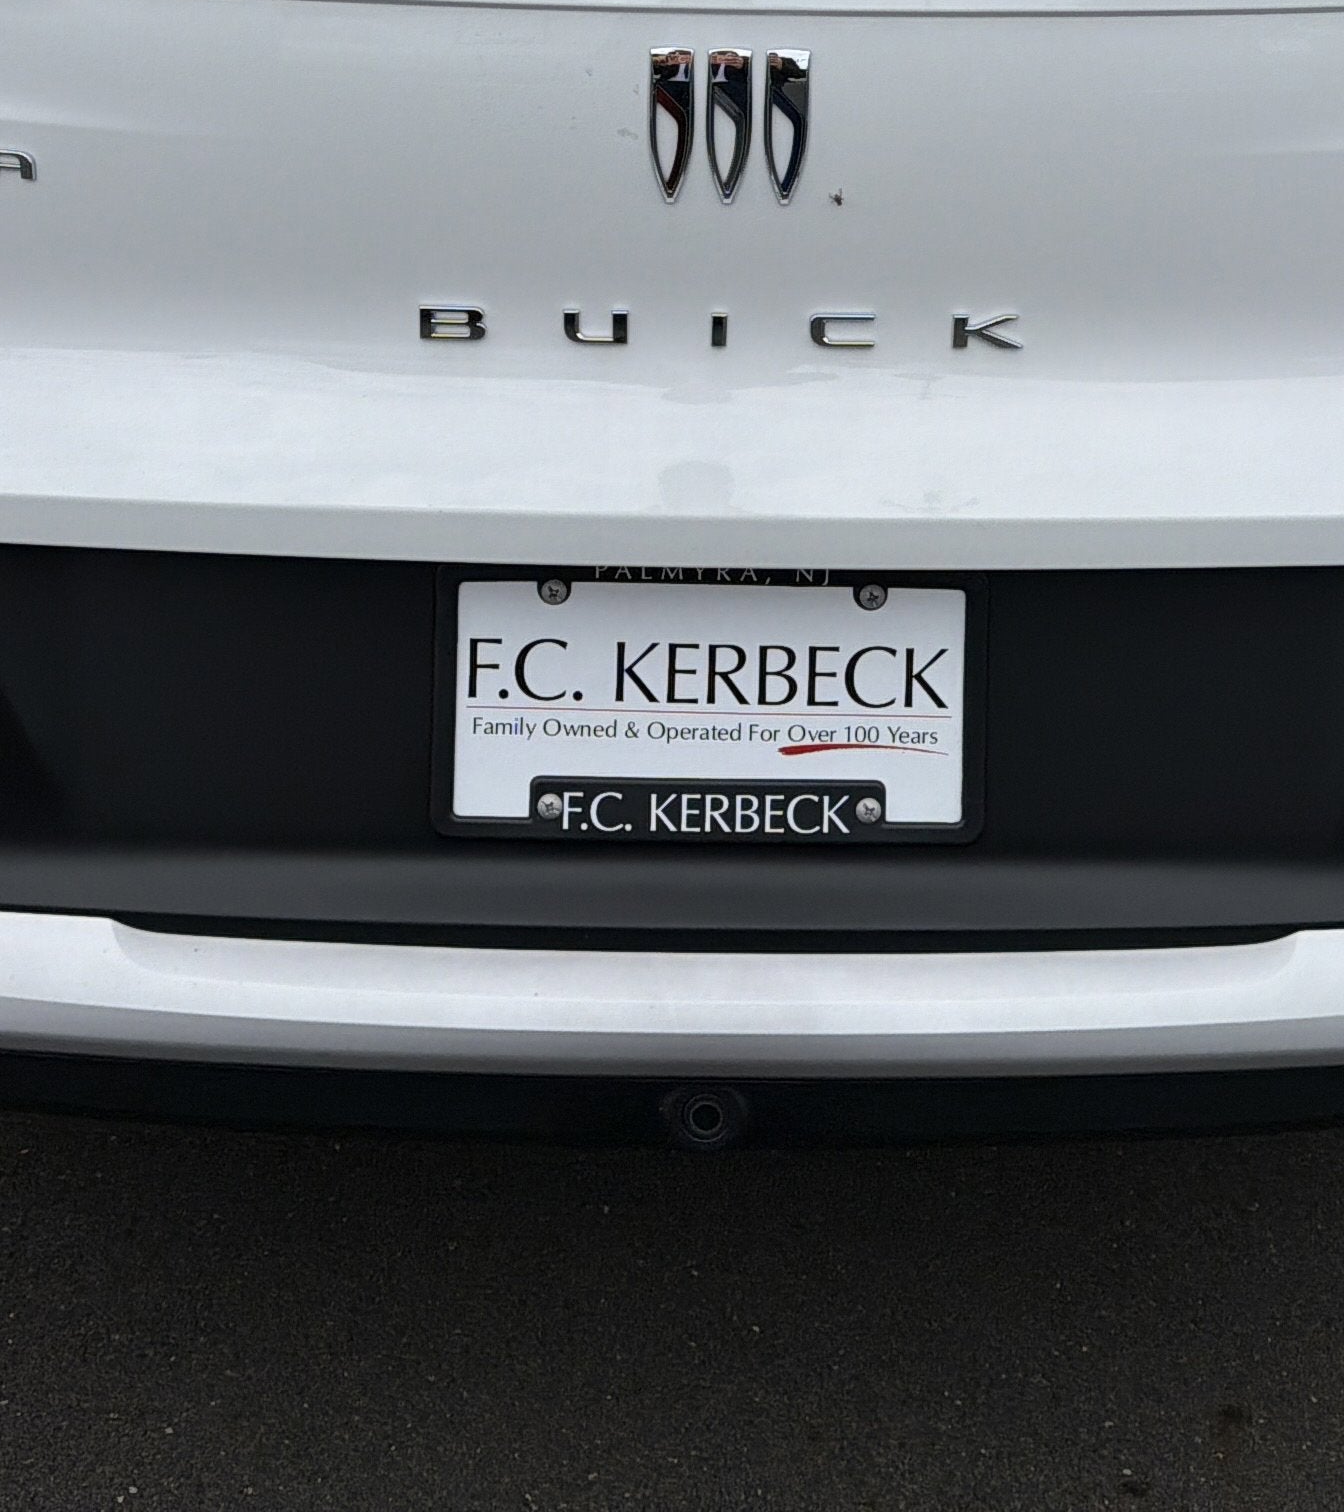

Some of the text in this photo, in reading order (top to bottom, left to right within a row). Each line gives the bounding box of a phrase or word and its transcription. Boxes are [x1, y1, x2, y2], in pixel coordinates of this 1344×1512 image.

[419, 305, 1023, 350] BUICK
[467, 638, 950, 710] F.C. KERBECK
[472, 716, 939, 745] Family Owned & Operated For Over 100 Years
[562, 791, 851, 835] F.C. KERBECK
